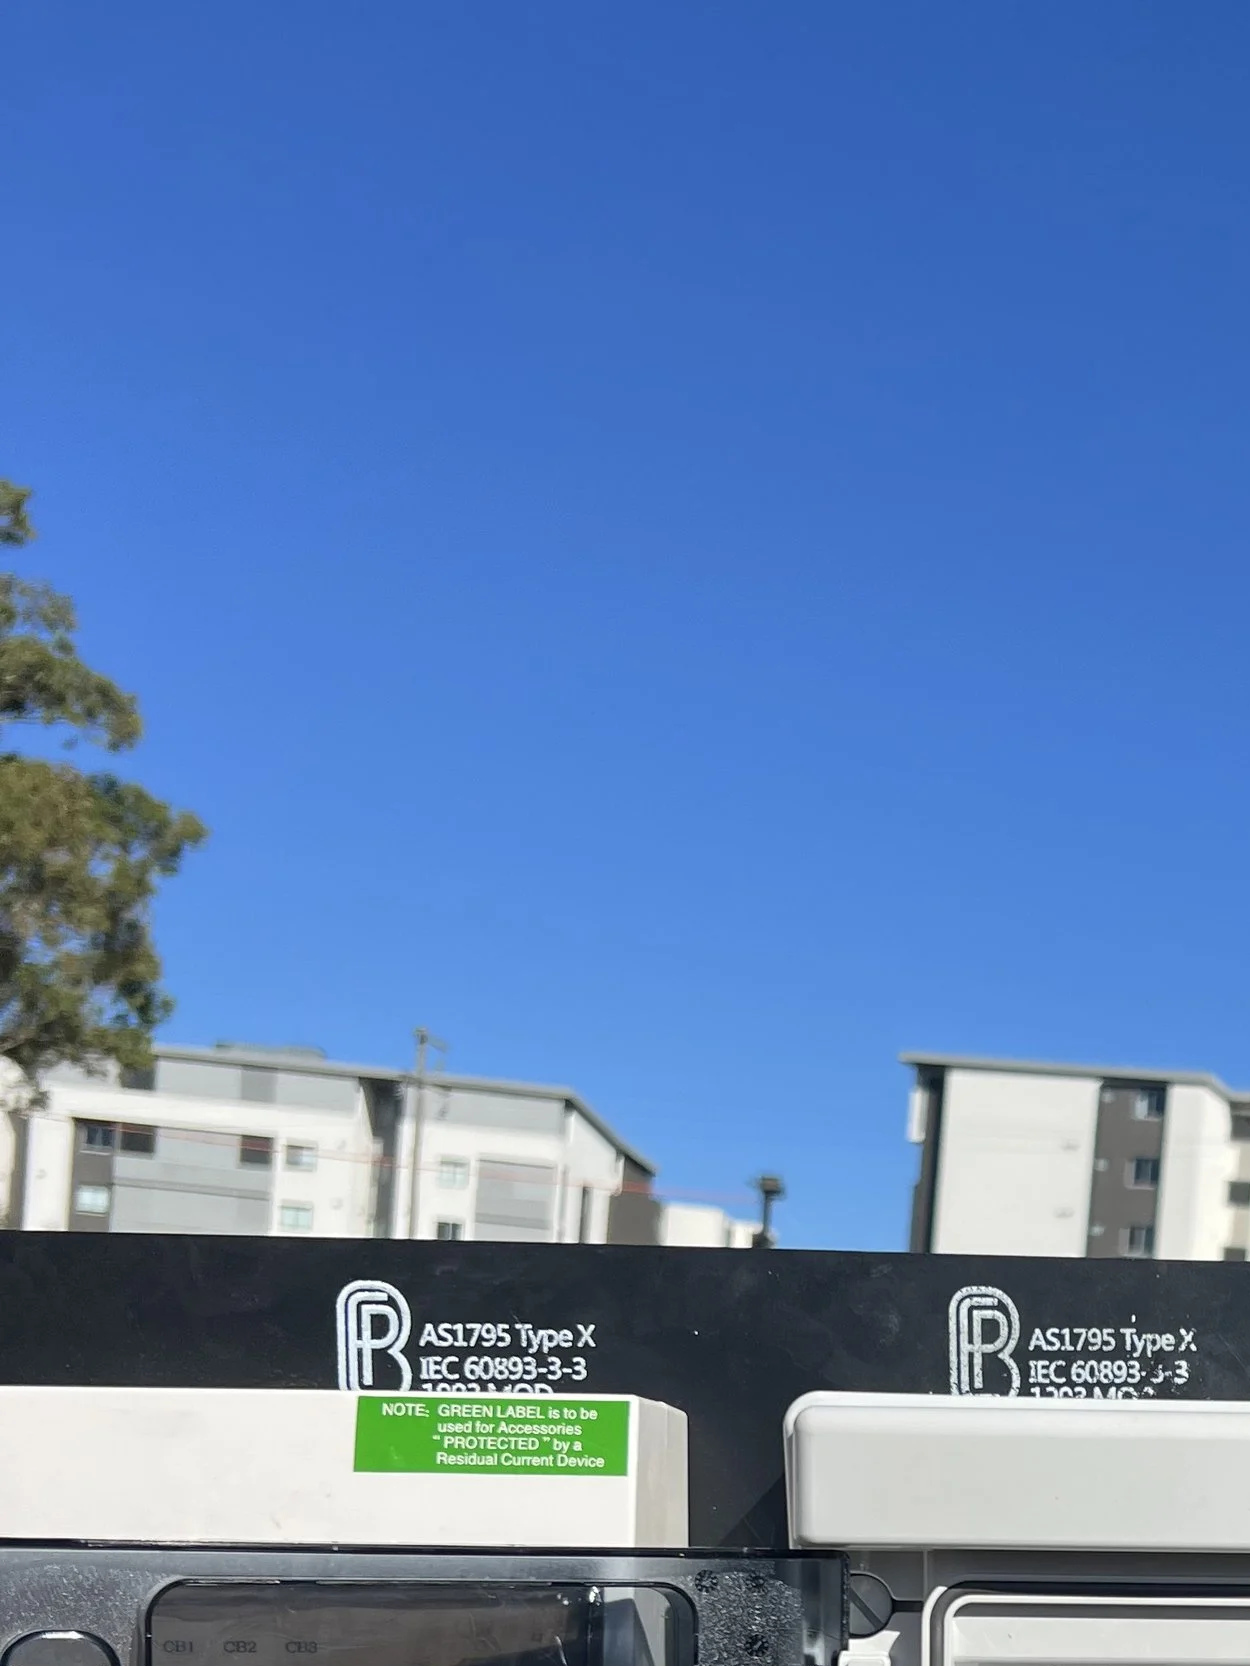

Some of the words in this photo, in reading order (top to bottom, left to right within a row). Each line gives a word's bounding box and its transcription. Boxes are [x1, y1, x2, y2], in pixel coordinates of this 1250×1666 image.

[418, 1323, 511, 1347] AS1795
[514, 1323, 574, 1354] Type
[576, 1324, 597, 1347] X
[1028, 1328, 1116, 1351] AS1795
[1119, 1328, 1176, 1357] Type
[1178, 1328, 1198, 1351] X
[419, 1356, 460, 1380] IEC
[463, 1356, 588, 1380] 60893-3-3
[1028, 1360, 1067, 1383] IEC
[381, 1402, 430, 1417] NOTE:
[437, 1403, 494, 1418] GREEN
[496, 1405, 546, 1419] LABEL
[548, 1406, 561, 1419] is
[563, 1407, 577, 1419] to
[580, 1407, 598, 1420] be
[437, 1420, 473, 1434] used
[475, 1421, 494, 1434] for
[499, 1421, 583, 1436] Accessories
[443, 1437, 540, 1450] PROTECTED
[552, 1438, 570, 1453] by
[573, 1441, 583, 1452] a
[436, 1452, 498, 1466] Residual
[500, 1452, 554, 1467] Current
[557, 1454, 605, 1468] Device
[163, 1640, 195, 1654] CB1
[223, 1640, 257, 1654] CB2
